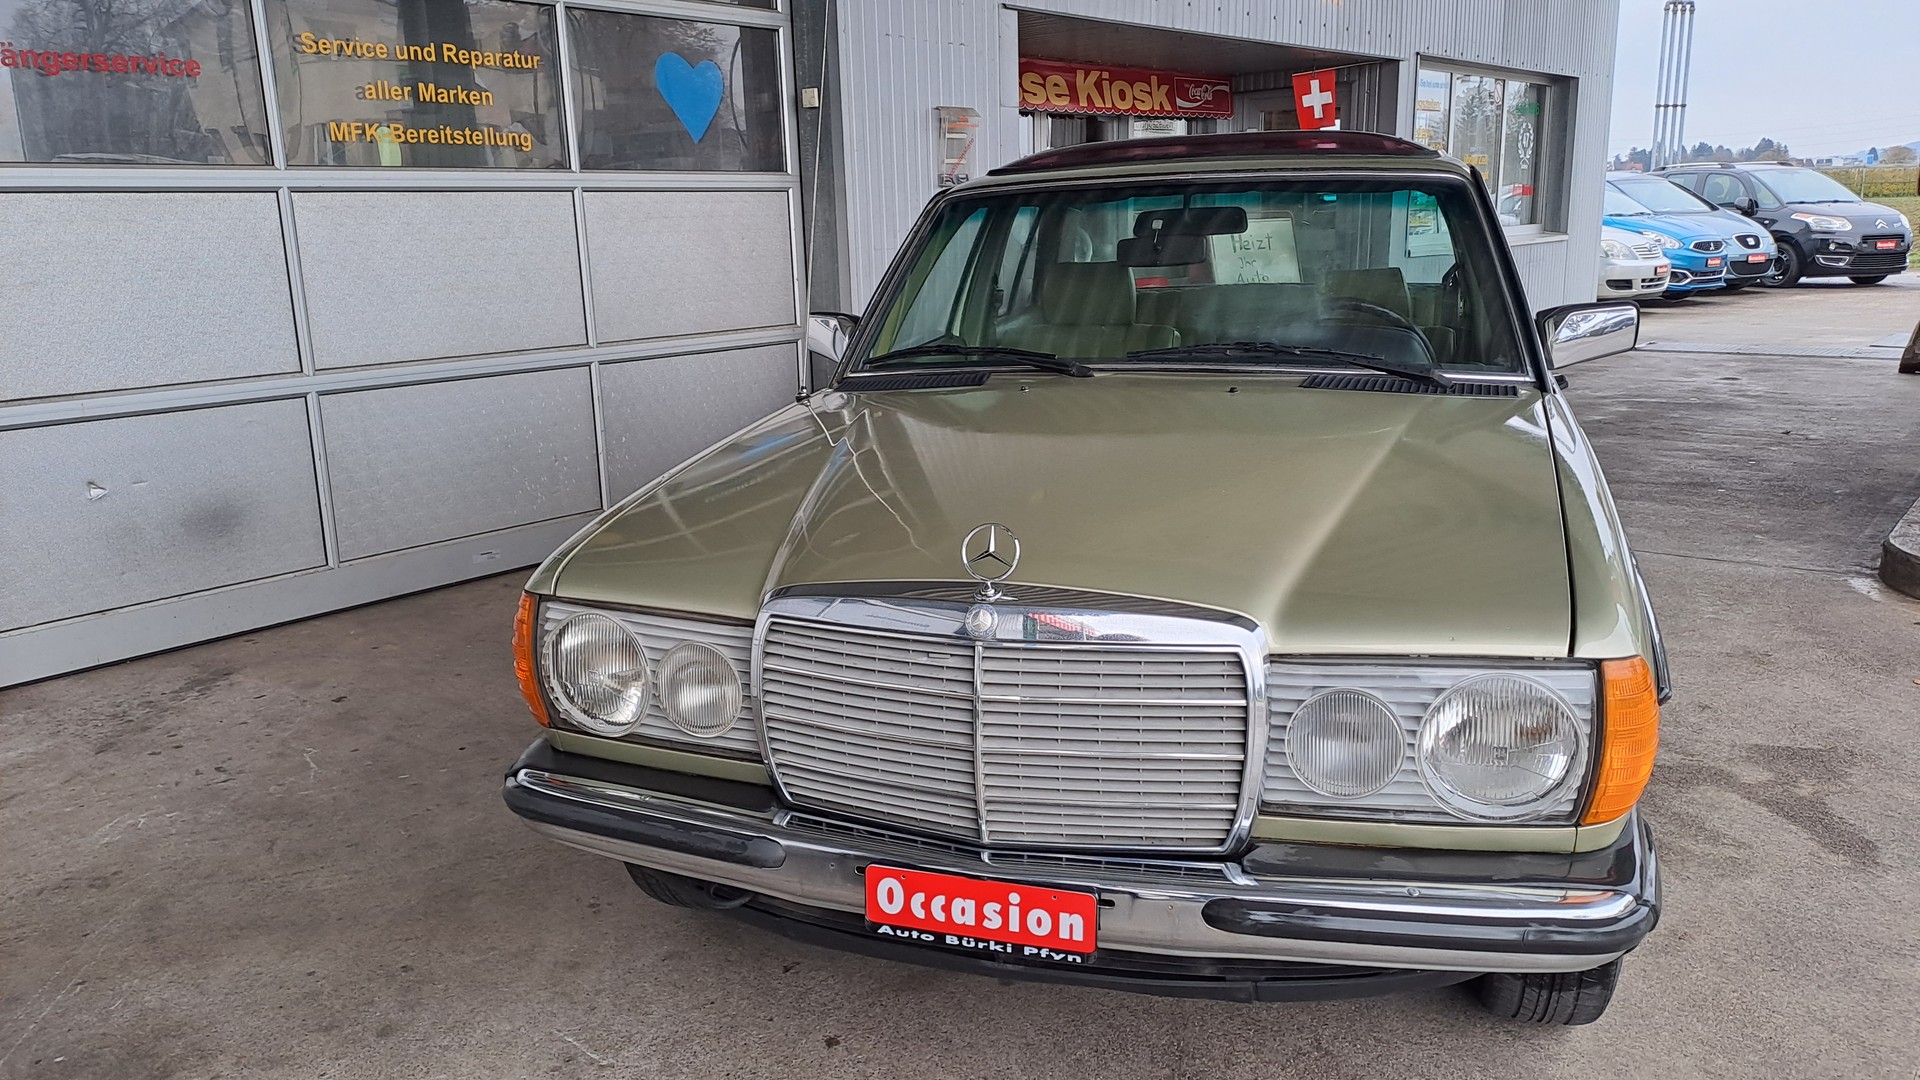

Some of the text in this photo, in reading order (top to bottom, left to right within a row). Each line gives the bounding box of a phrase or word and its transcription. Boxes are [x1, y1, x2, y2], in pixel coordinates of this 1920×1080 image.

[0, 41, 202, 77] ängerservice
[300, 32, 541, 69] Service und Reparatur
[365, 80, 494, 106] aller Marken
[1019, 69, 1173, 111] se Kiosk
[329, 121, 533, 152] MFK-Bereitstellung
[1230, 233, 1273, 254] Heizt
[1237, 270, 1270, 284] Auto
[876, 876, 1084, 942] Occasion
[877, 924, 1083, 964] Auto Bürki Pfyn
